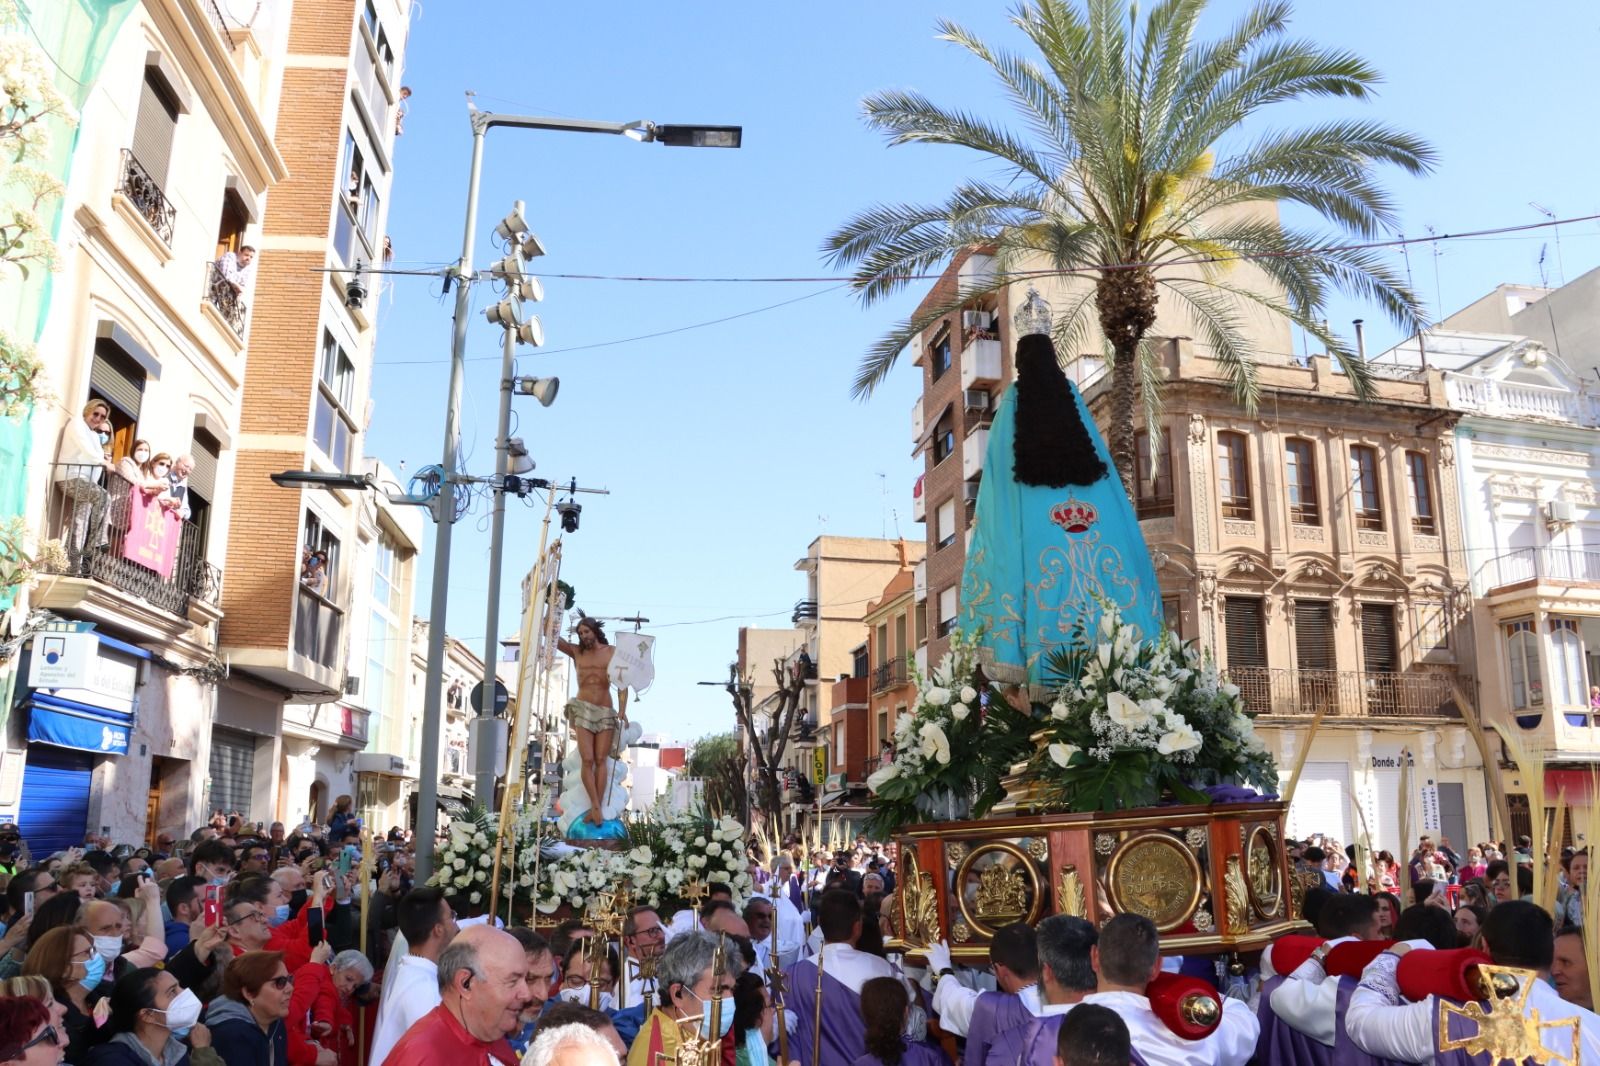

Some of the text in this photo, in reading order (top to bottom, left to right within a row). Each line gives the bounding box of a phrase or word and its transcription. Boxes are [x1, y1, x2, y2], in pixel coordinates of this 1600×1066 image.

[814, 748, 824, 784] FLORS
[1372, 756, 1414, 768] Donde Jn
[1421, 787, 1429, 830] FOTOCOPIAS
[1430, 787, 1438, 830] IMPRESIONES
